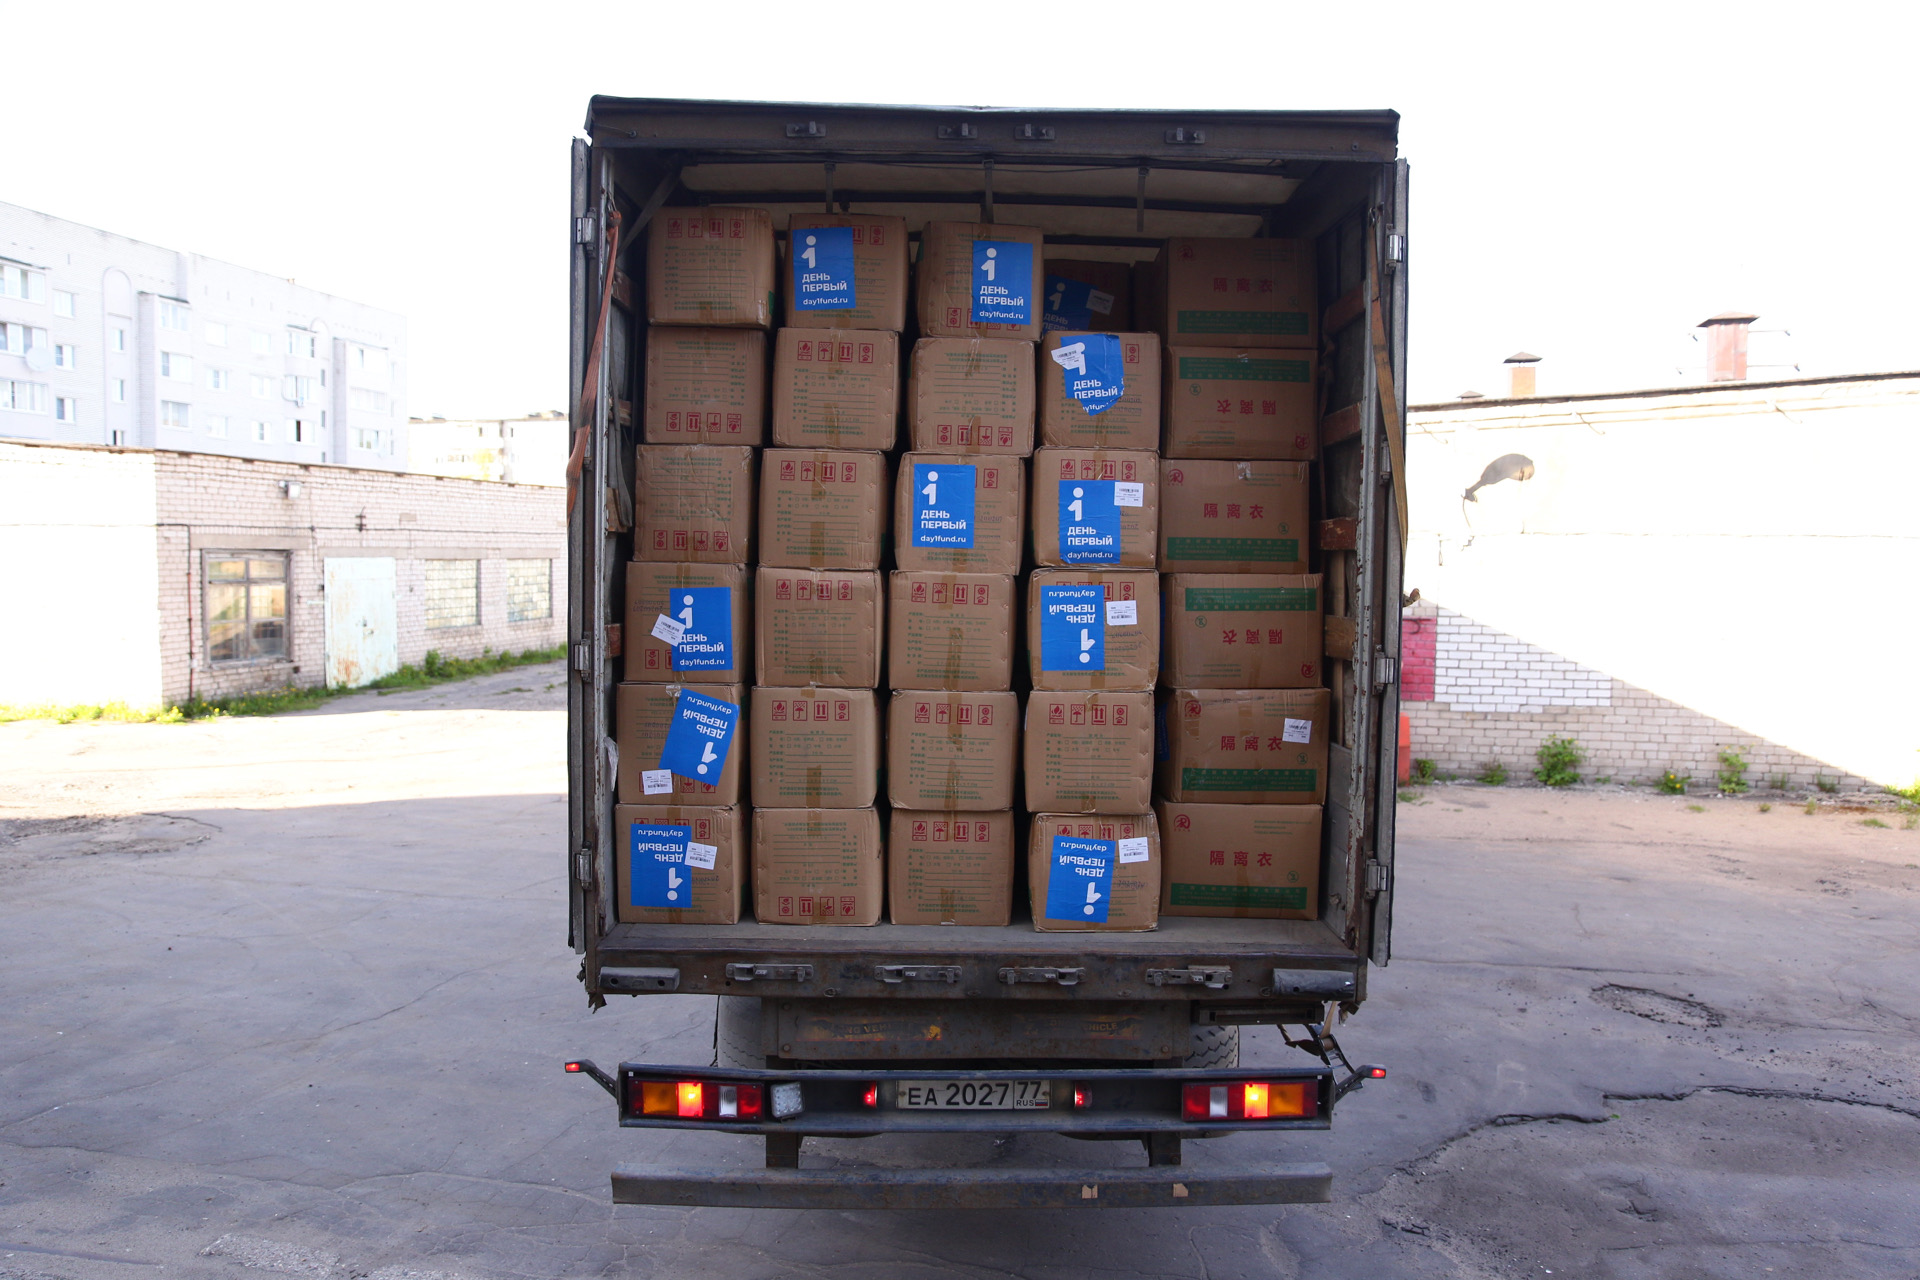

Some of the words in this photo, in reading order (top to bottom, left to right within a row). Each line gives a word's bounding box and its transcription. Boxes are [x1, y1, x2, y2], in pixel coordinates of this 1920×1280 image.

[802, 273, 830, 283] ДЕНЬ
[803, 281, 847, 292] ПЕРВЫЙ
[980, 286, 1008, 294] ДЕНЬ
[803, 297, 848, 305] day1fund.ru
[980, 296, 1023, 306] ПЕРВЫЙ
[980, 311, 1023, 319] day1fund.ru
[1043, 313, 1068, 325] ДЕНЬ
[1043, 322, 1080, 330] ПЕРВ
[1073, 379, 1102, 390] ДЕНЬ
[1074, 386, 1118, 399] ПЕРВЫЙ
[921, 510, 950, 519] ДЕНЬ
[1204, 503, 1264, 519] 隔离衣
[921, 520, 966, 529] ПЕРВЫЙ
[1068, 527, 1096, 536] ДЕНЬ
[921, 535, 966, 544] day1fund.ru
[1068, 535, 1112, 545] ПЕРВЫЙ
[1049, 604, 1095, 615] ПЕРВЫЙ
[1066, 614, 1095, 623] ДЕНЬ
[680, 634, 707, 642] ДЕНЬ
[680, 642, 724, 652] ПЕРВЫЙ
[687, 697, 732, 714] day1fund.ru
[683, 707, 728, 729] ПЕРВЫЙ
[696, 724, 725, 739] ДЕНЬ
[1221, 736, 1282, 751] 隔离衣
[638, 843, 682, 852] ПЕРВЫЙ
[1061, 842, 1107, 852] day1fund.ru
[655, 854, 683, 862] ДЕНЬ
[1059, 855, 1105, 867] ПЕРВЫЙ
[1210, 851, 1272, 867] 隔离衣
[1075, 868, 1104, 877] ДЕНЬ
[946, 1083, 1009, 1106] 2027
[1017, 1081, 1042, 1099] 77
